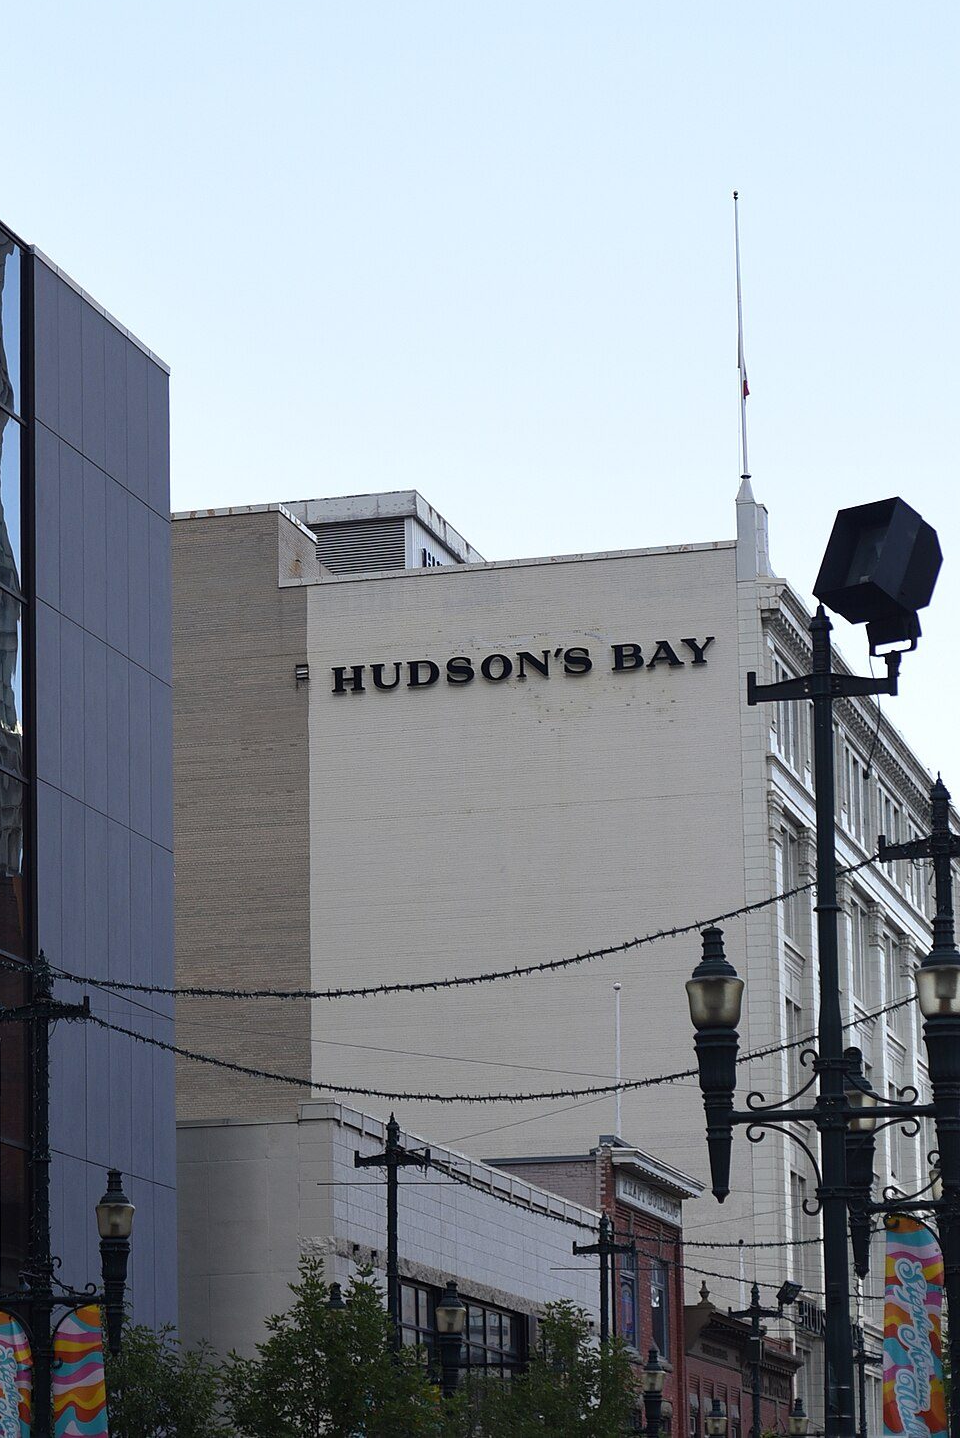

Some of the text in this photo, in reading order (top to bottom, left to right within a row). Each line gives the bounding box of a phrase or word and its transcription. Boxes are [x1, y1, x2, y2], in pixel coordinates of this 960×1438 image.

[331, 636, 715, 693] HUDSON'S BAY
[896, 1262, 933, 1409] Stephen Avenue
